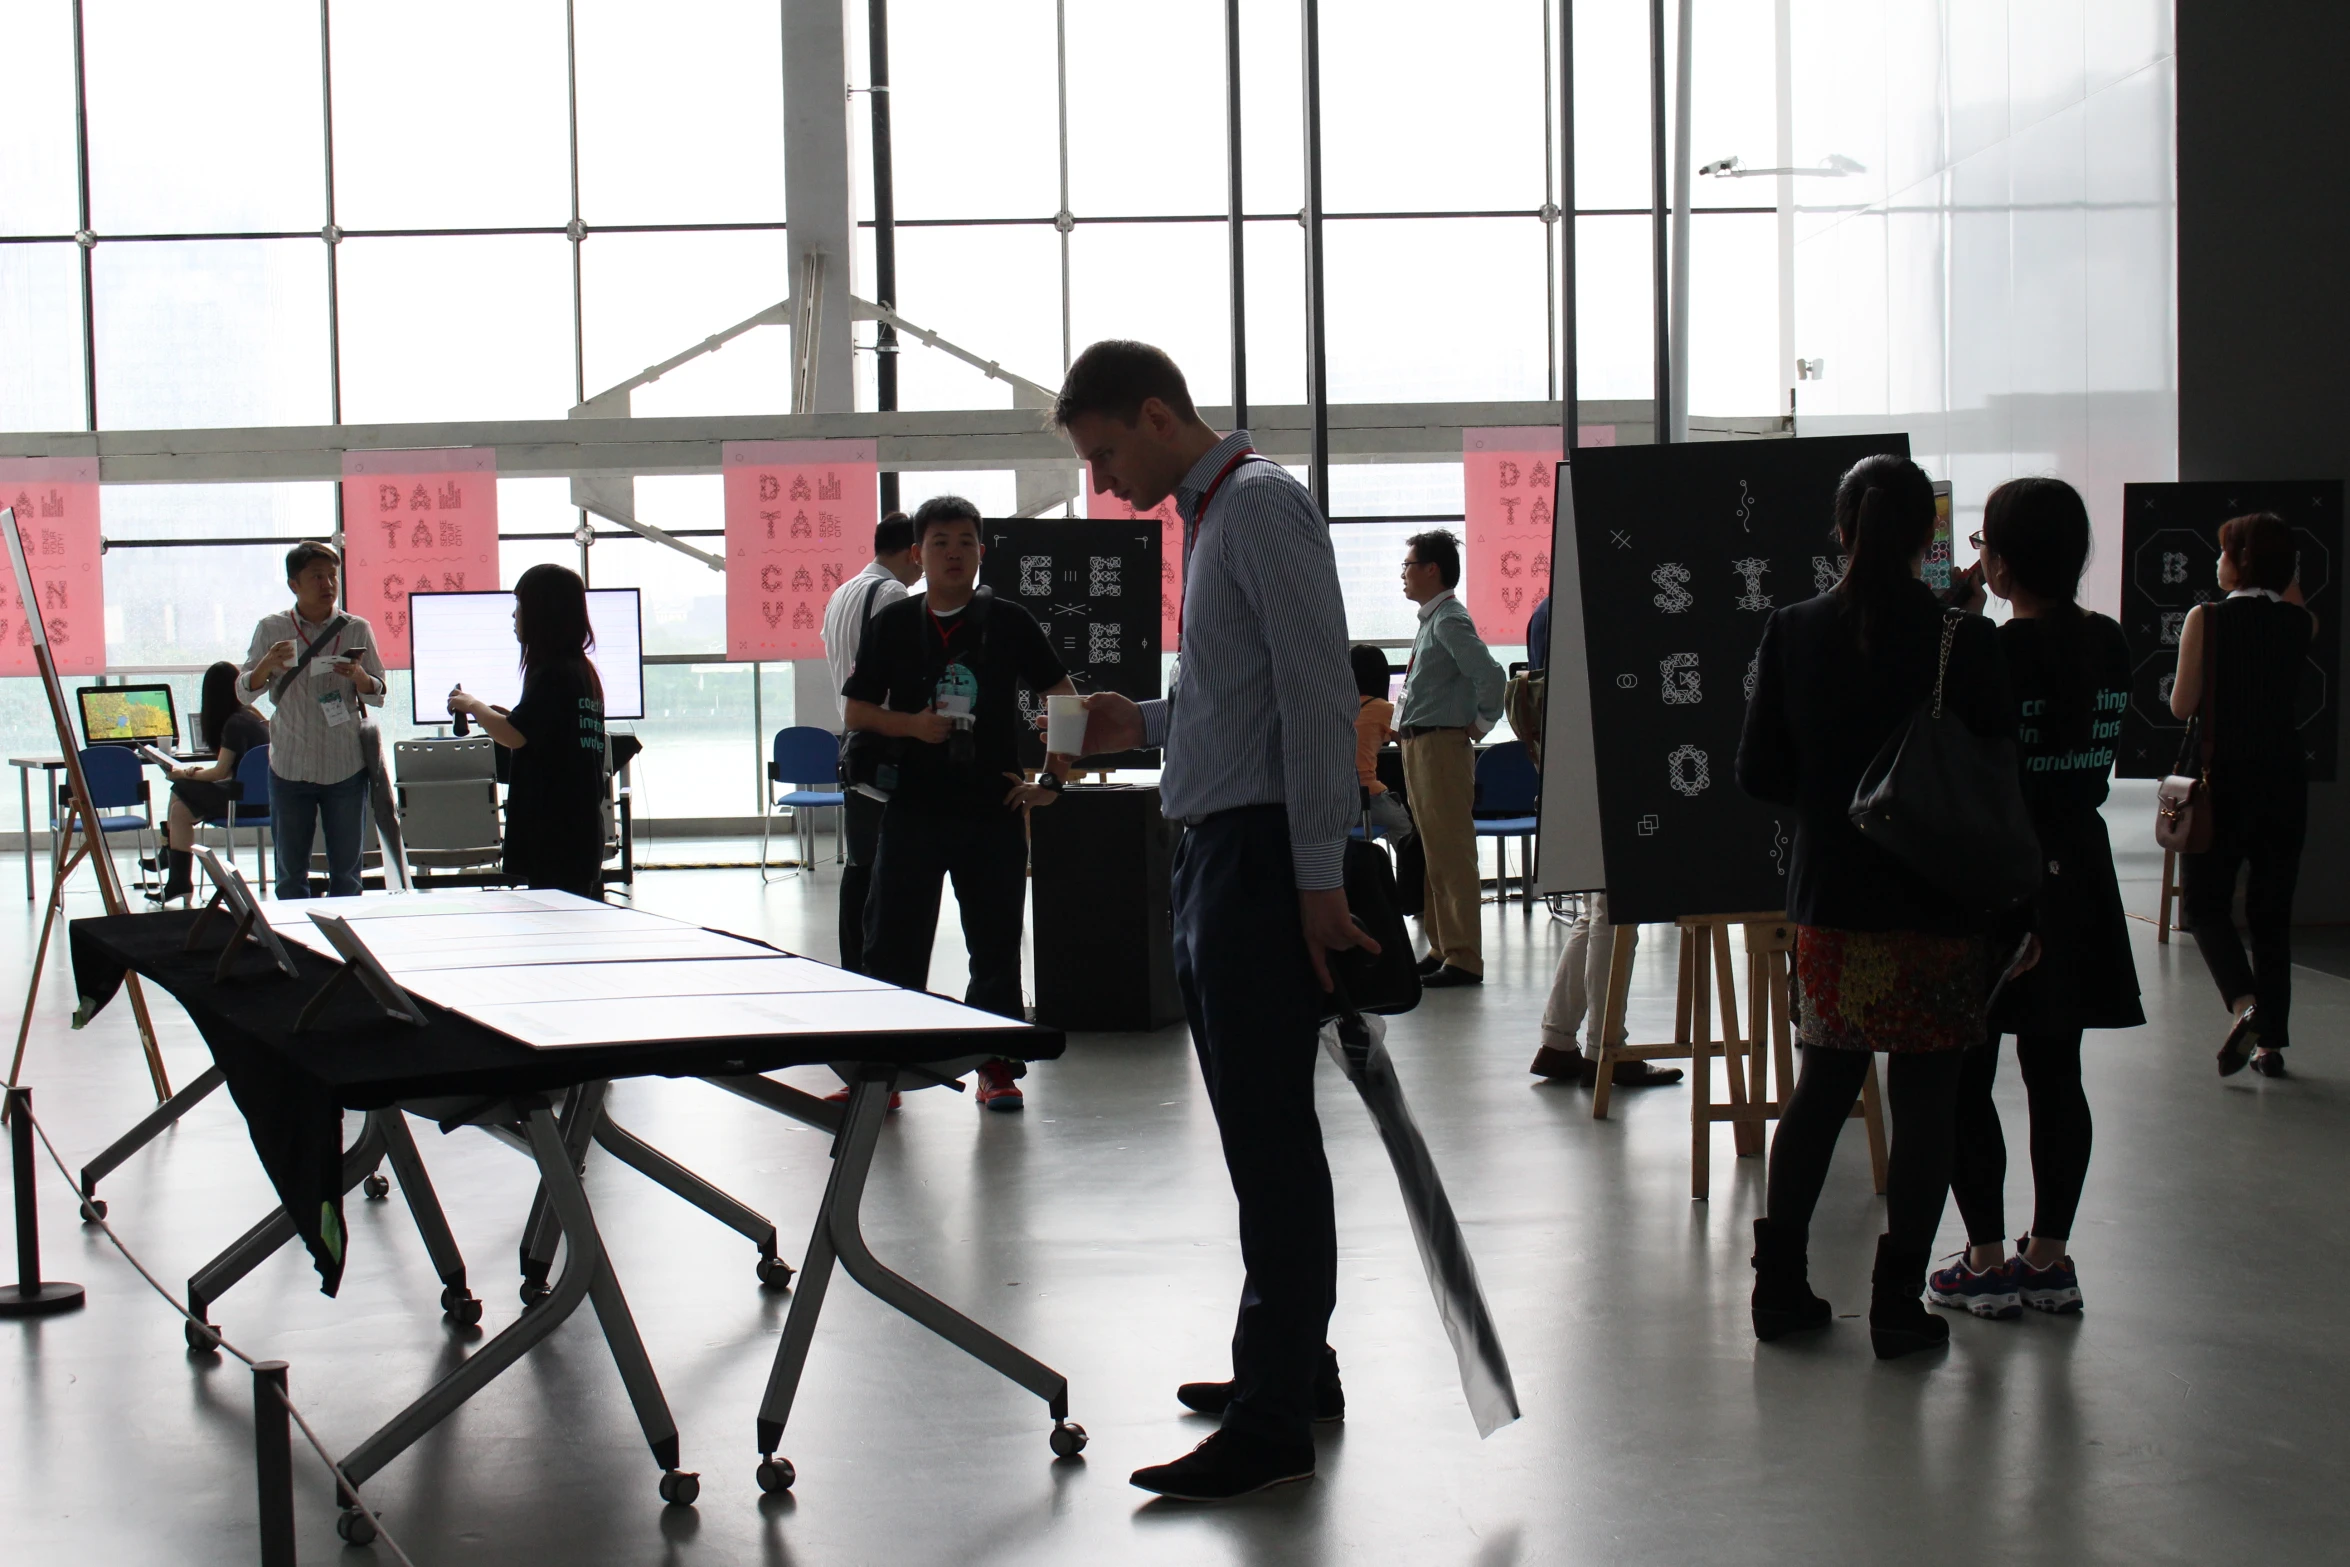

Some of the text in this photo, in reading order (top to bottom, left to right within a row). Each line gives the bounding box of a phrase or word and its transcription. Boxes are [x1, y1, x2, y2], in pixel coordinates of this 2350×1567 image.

[440, 520, 448, 547] SENSE
[447, 523, 455, 547] YOUR
[455, 525, 463, 547] CITY!
[819, 511, 827, 538] SENSE
[834, 516, 842, 538] CITY!
[42, 528, 50, 555] SENSE
[57, 533, 65, 555] CITY!
[762, 602, 828, 629] VA
